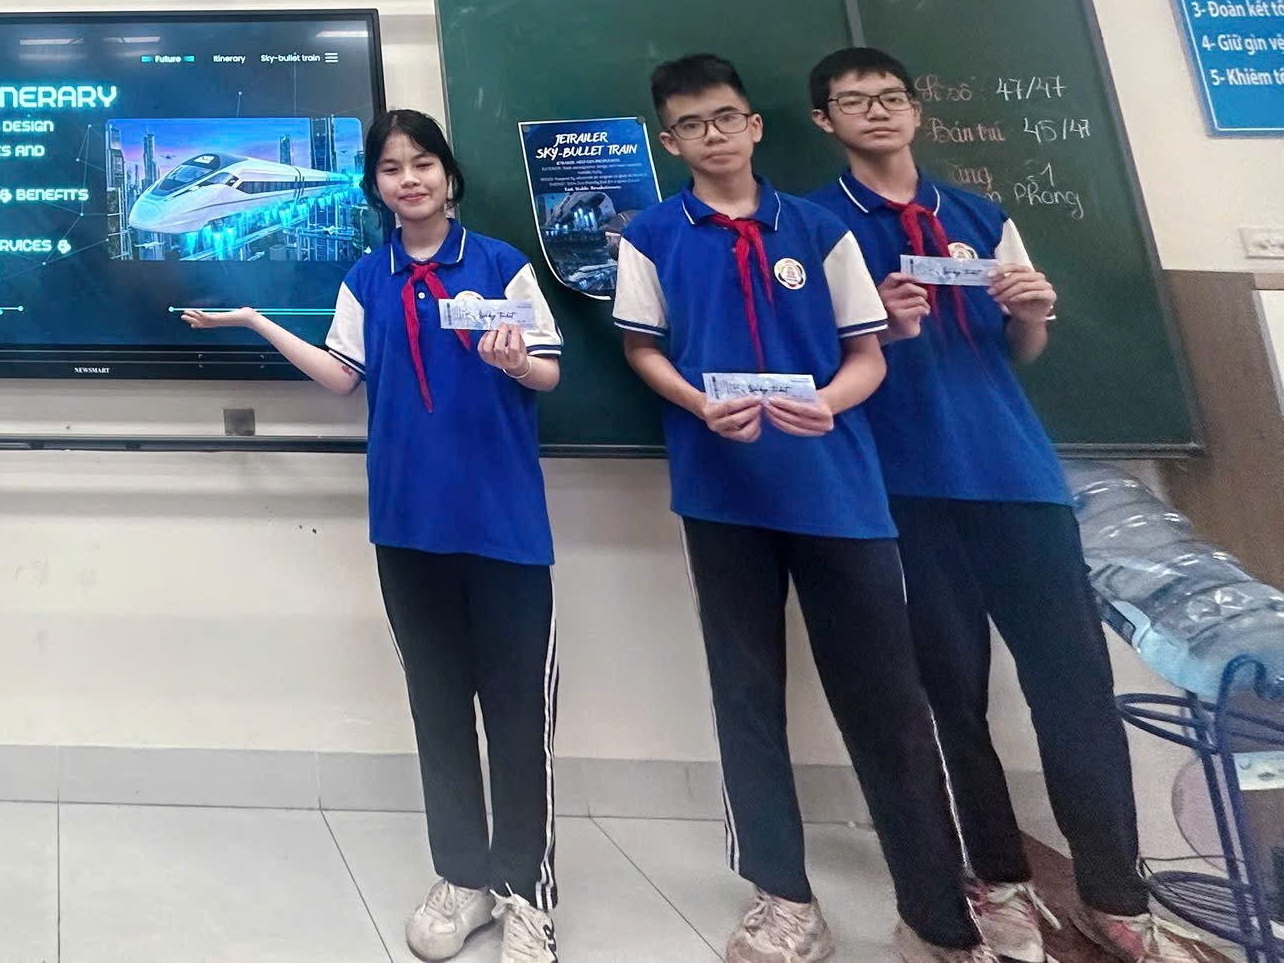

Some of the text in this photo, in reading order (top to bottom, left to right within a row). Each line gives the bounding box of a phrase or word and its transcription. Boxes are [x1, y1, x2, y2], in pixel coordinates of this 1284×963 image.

[1207, 0, 1246, 17] Đoàn
[1217, 33, 1243, 51] Giữ
[1244, 33, 1267, 55] gìn
[155, 55, 182, 63] Future
[213, 54, 246, 64] Itinerary
[260, 54, 321, 64] Sky-bullet train
[1226, 67, 1273, 85] Khiêm
[996, 75, 1067, 101] 47/47
[2, 120, 54, 132] DESIGN
[1023, 118, 1091, 144] 45/47
[553, 132, 608, 147] JETRAILER
[15, 145, 45, 157] AND
[536, 144, 638, 161] SKY-BULLET TRAIN
[16, 188, 89, 201] BENEFITS
[57, 239, 72, 254] &
